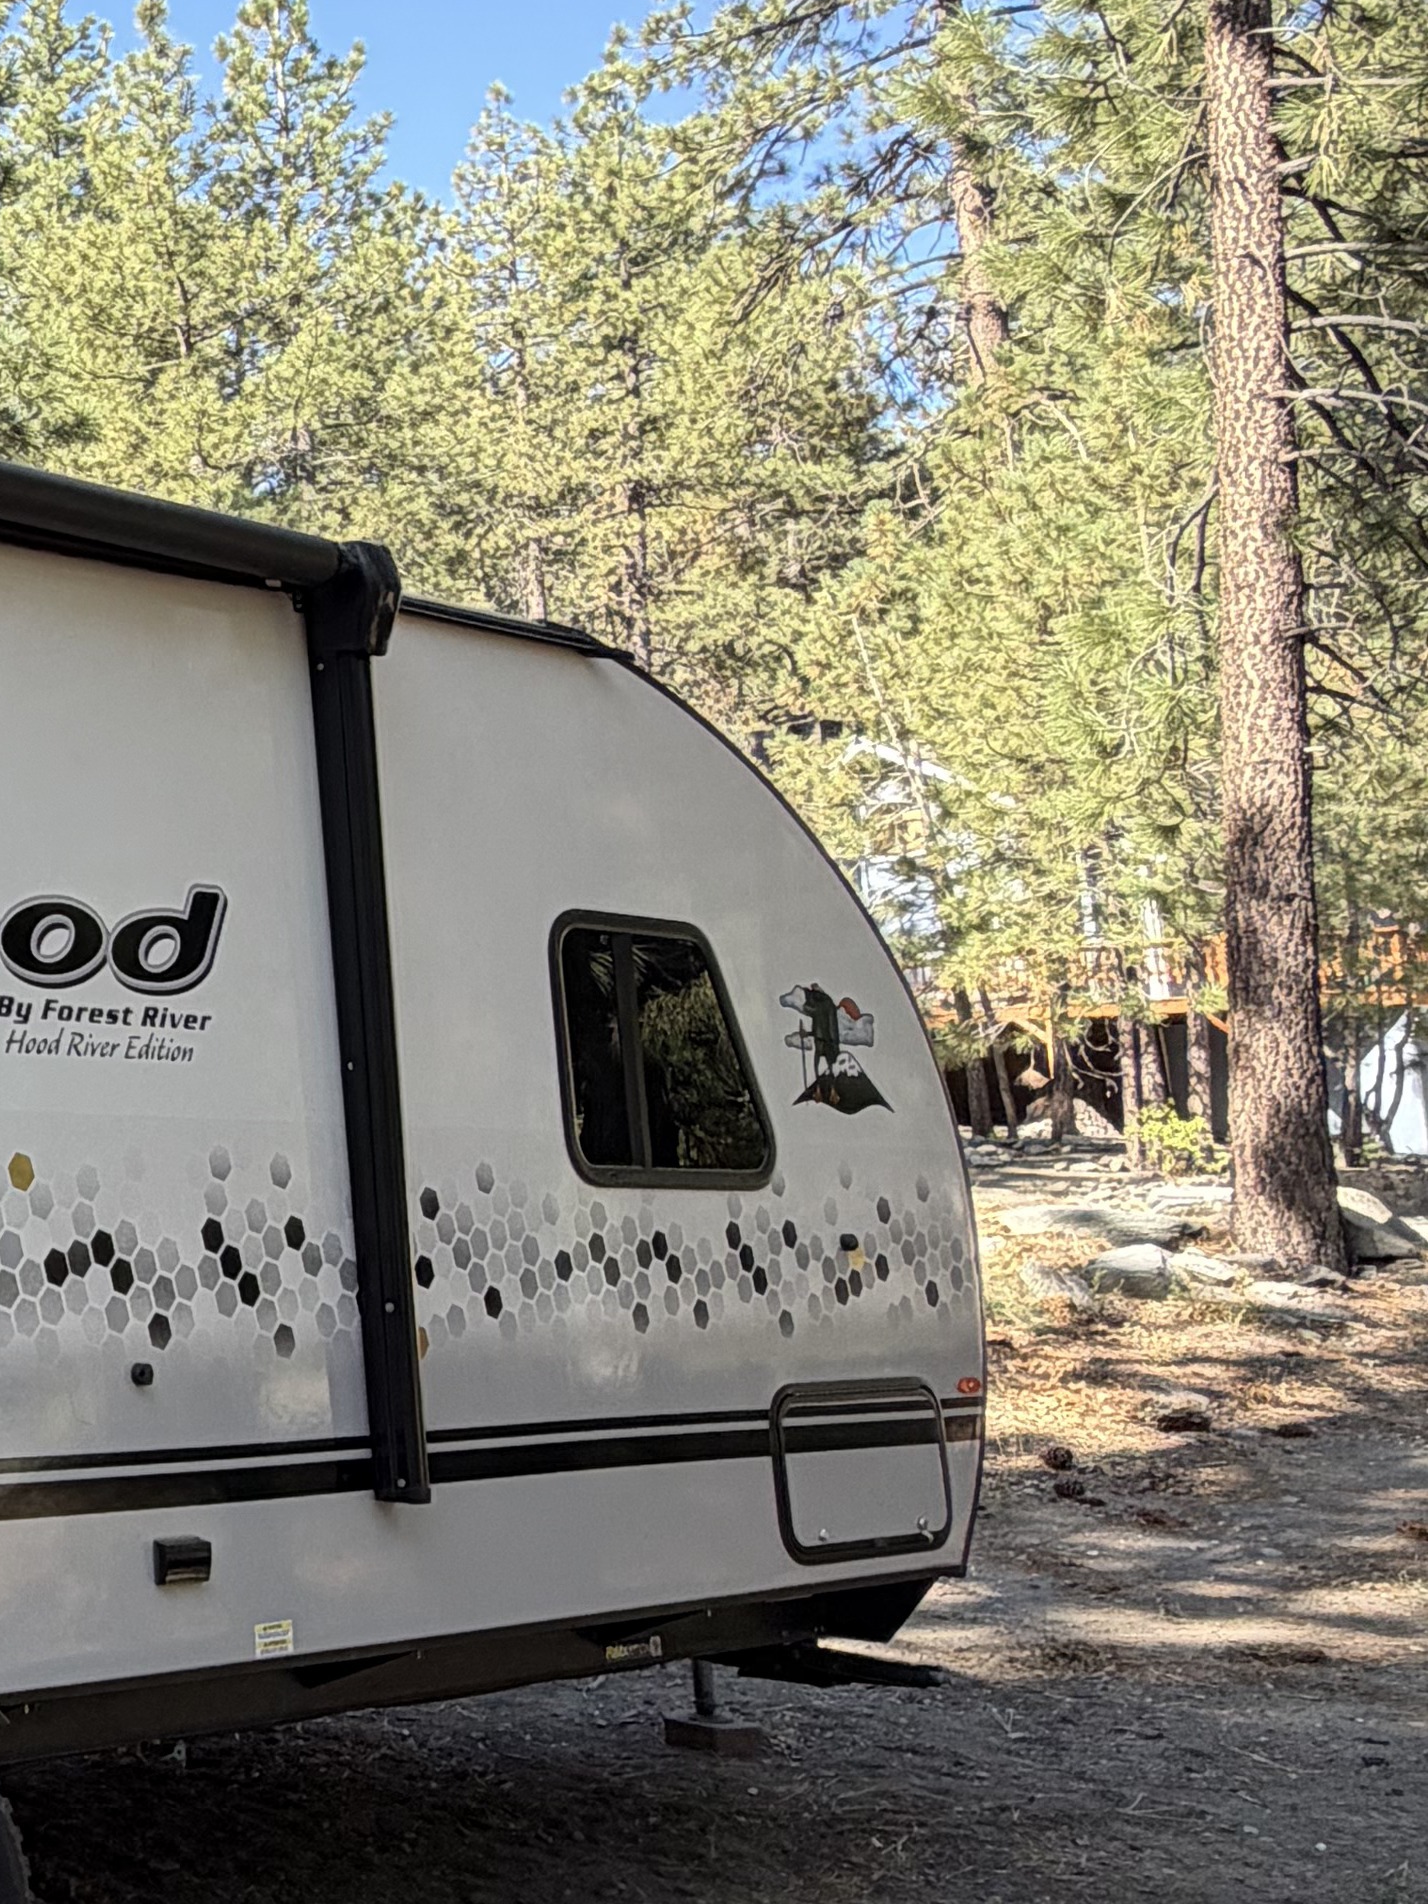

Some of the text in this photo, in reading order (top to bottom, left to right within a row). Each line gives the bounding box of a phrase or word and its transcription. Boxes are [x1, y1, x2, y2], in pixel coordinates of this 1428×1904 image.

[40, 998, 134, 1027] Forest
[140, 1006, 213, 1032] River
[4, 1026, 194, 1062] Hood River Edition
